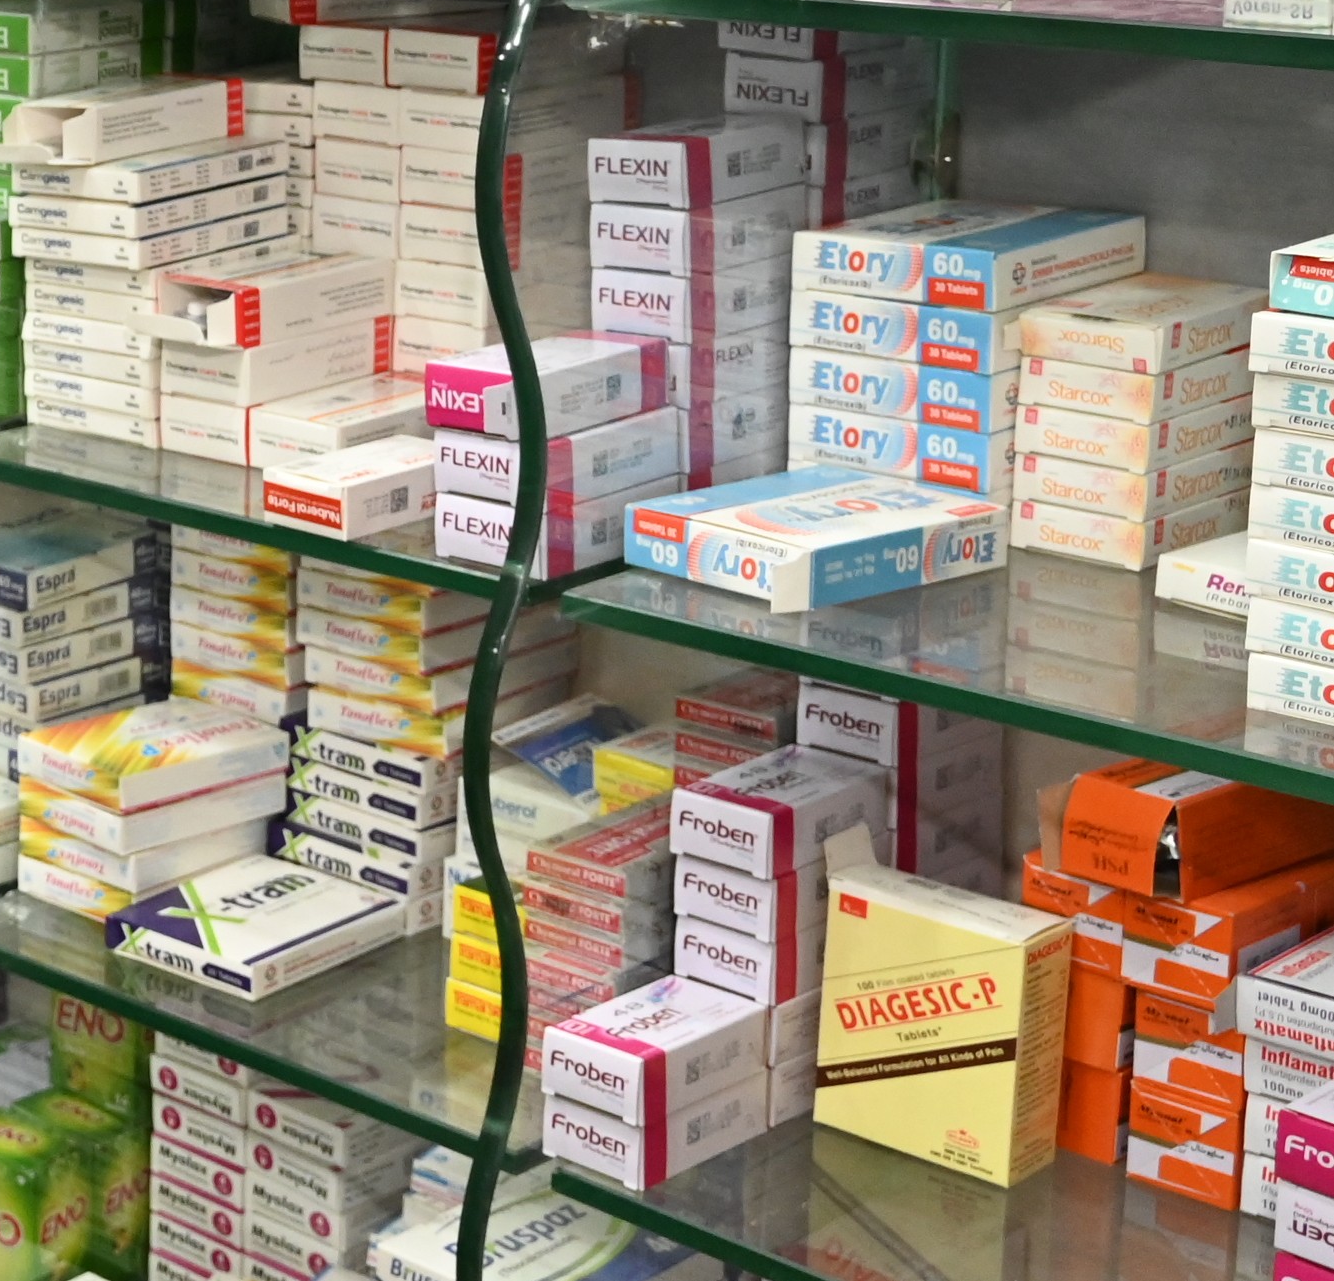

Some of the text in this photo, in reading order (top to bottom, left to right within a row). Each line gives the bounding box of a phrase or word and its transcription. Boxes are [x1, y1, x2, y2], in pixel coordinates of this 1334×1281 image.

[595, 157, 668, 176] FLEXIN
[819, 240, 895, 281] Etory
[1058, 328, 1124, 353] Starcox
[811, 361, 890, 401] Etory
[1048, 381, 1113, 406] Starcox
[811, 417, 889, 457] Etory
[441, 447, 511, 474] FLEXIN
[1042, 479, 1106, 505] Starcox
[805, 703, 883, 736] Froben
[292, 727, 365, 770] X-tram
[678, 810, 759, 848] Froben
[117, 923, 194, 970] X-tram
[683, 934, 762, 973] Froben
[56, 997, 125, 1041] ENO
[836, 977, 997, 1030] DIAGESIC-P
[895, 1027, 938, 1043] Tablets
[550, 1051, 628, 1090] Froben
